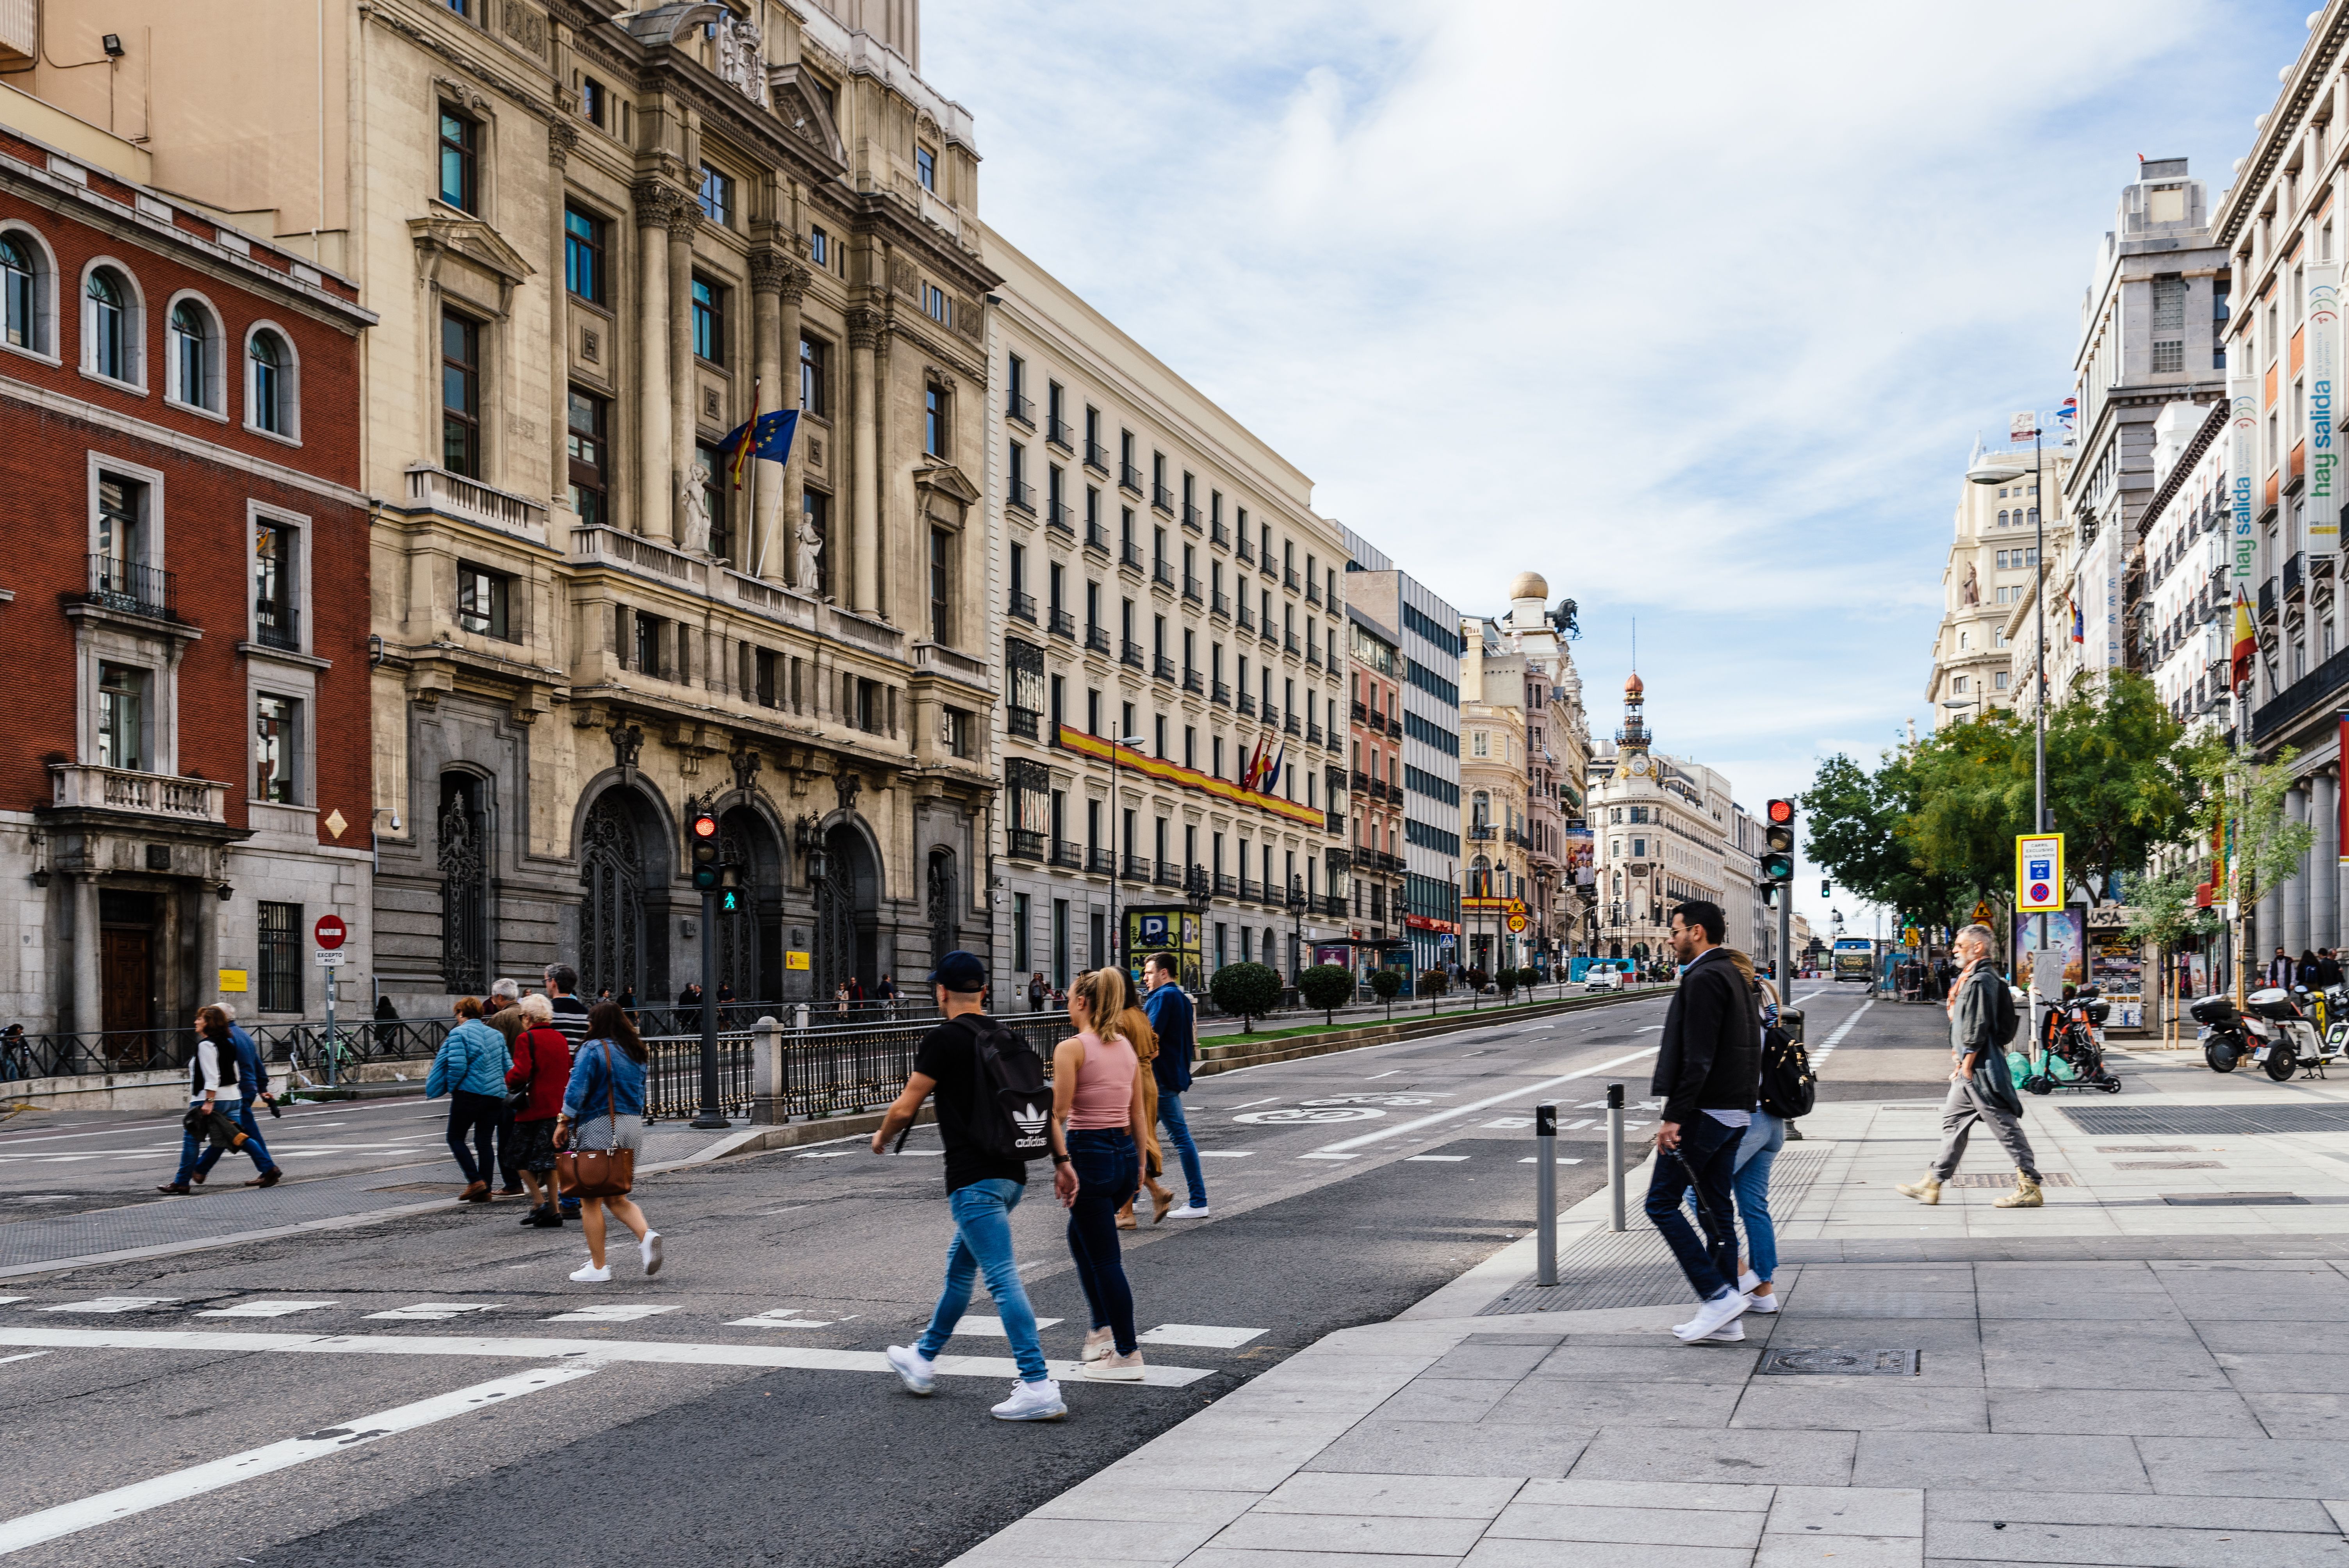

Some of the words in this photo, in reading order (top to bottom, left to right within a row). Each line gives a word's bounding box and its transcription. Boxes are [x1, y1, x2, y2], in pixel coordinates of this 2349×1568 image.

[2324, 369, 2330, 377] de
[2309, 380, 2331, 448] salida
[2310, 453, 2338, 497] hay
[2232, 476, 2251, 535] salida
[2232, 539, 2257, 577] hay
[687, 923, 697, 933] 34
[797, 932, 805, 941] 34
[1146, 919, 1163, 941] P
[1185, 920, 1190, 940] P
[1478, 1117, 1653, 1131] BUS
[1015, 1135, 1047, 1147] adidas
